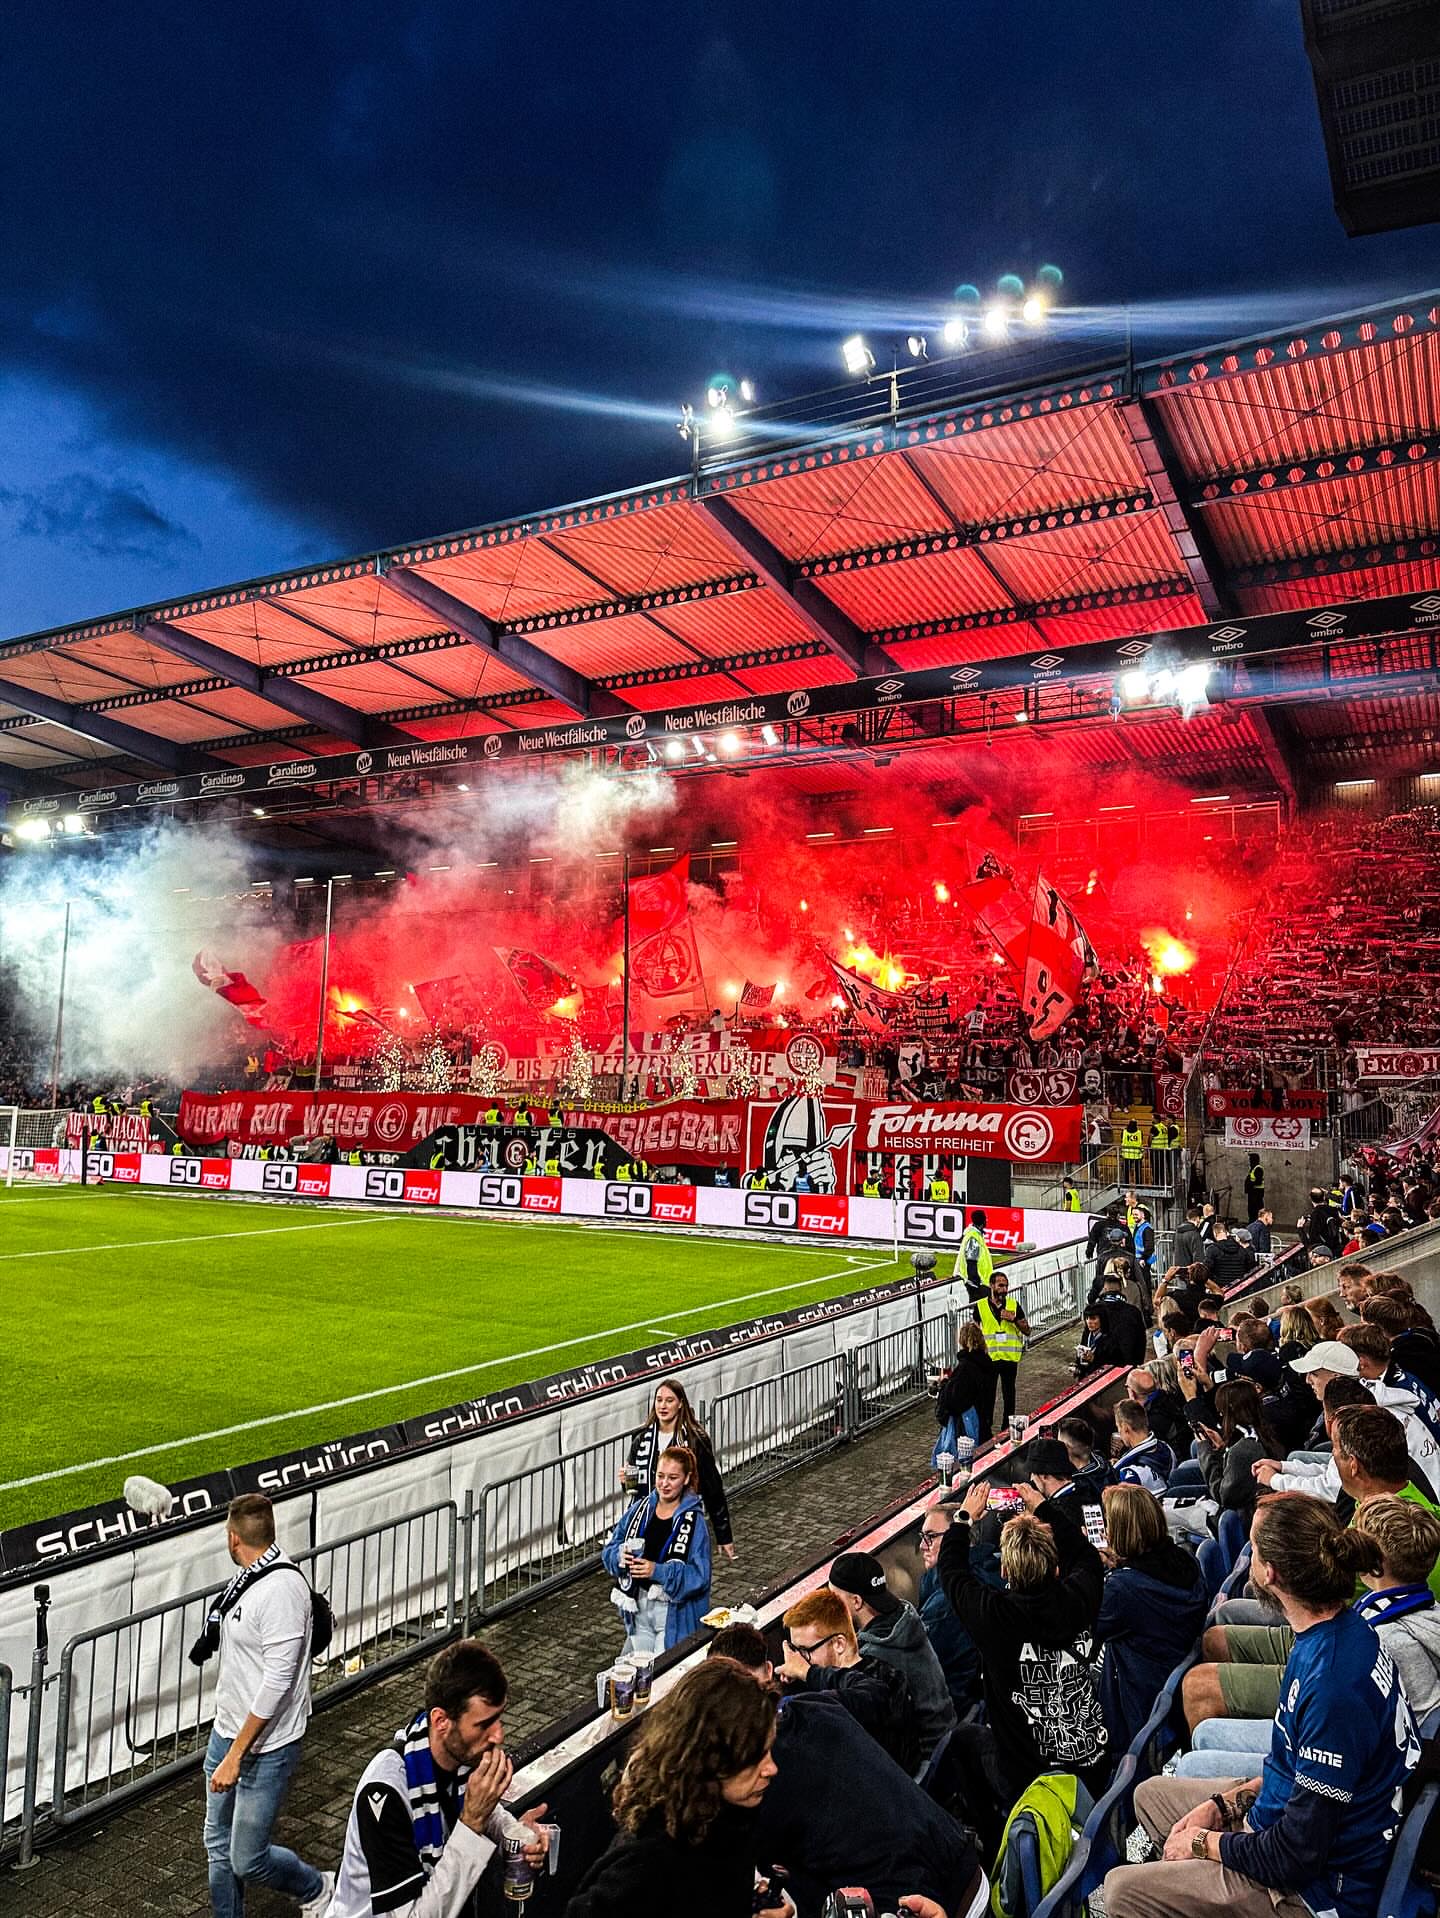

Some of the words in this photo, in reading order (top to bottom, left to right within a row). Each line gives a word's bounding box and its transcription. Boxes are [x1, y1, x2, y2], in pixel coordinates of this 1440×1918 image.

[1310, 627, 1343, 638] umbro
[1212, 642, 1244, 652] umbro
[1120, 655, 1150, 665] umbro
[1033, 669, 1061, 678] umbro
[878, 693, 902, 702] umbro
[953, 682, 979, 690] umbro
[664, 714, 693, 731] Neue
[694, 703, 765, 727] Westfälische
[519, 735, 544, 750] Neue
[544, 726, 607, 746] Westfälische
[387, 752, 410, 768] Neue
[411, 744, 467, 764] Westfälische
[201, 773, 244, 787] Carolinen
[269, 762, 315, 776] Carolinen
[78, 791, 116, 804] Carolinen
[137, 782, 177, 795] Carolinen
[23, 800, 59, 812] Carolinen
[516, 1060, 541, 1079] BIS
[184, 1101, 243, 1135] VORAN
[250, 1102, 293, 1135] ROT
[304, 1103, 375, 1136] WEISS
[867, 1105, 1002, 1148] Fortuna
[884, 1136, 931, 1149] HEISST
[935, 1138, 995, 1152] FREIHEIT
[1024, 1140, 1036, 1148] 95
[86, 1154, 114, 1177] SO
[115, 1167, 139, 1179] TECH
[171, 1159, 200, 1183] SO
[202, 1172, 229, 1186] TECH
[264, 1165, 297, 1190] SO
[299, 1180, 328, 1193] TECH
[367, 1171, 403, 1198] SO
[406, 1187, 438, 1200] TECH
[481, 1177, 521, 1205] SO
[524, 1194, 558, 1208] TECH
[606, 1184, 651, 1215] SO
[654, 1202, 692, 1219] TECH
[747, 1193, 796, 1227] SO
[801, 1214, 845, 1231] TECH
[907, 1206, 963, 1240] SO
[980, 1228, 1019, 1246] ECH
[730, 1320, 784, 1343] SCHÜCO
[647, 1339, 713, 1368] SCHÜCO
[546, 1365, 627, 1399] SCHÜCO
[425, 1396, 523, 1438] SCHÜCO
[257, 1439, 389, 1488] SCHÜCO
[674, 1523, 692, 1554] DSC
